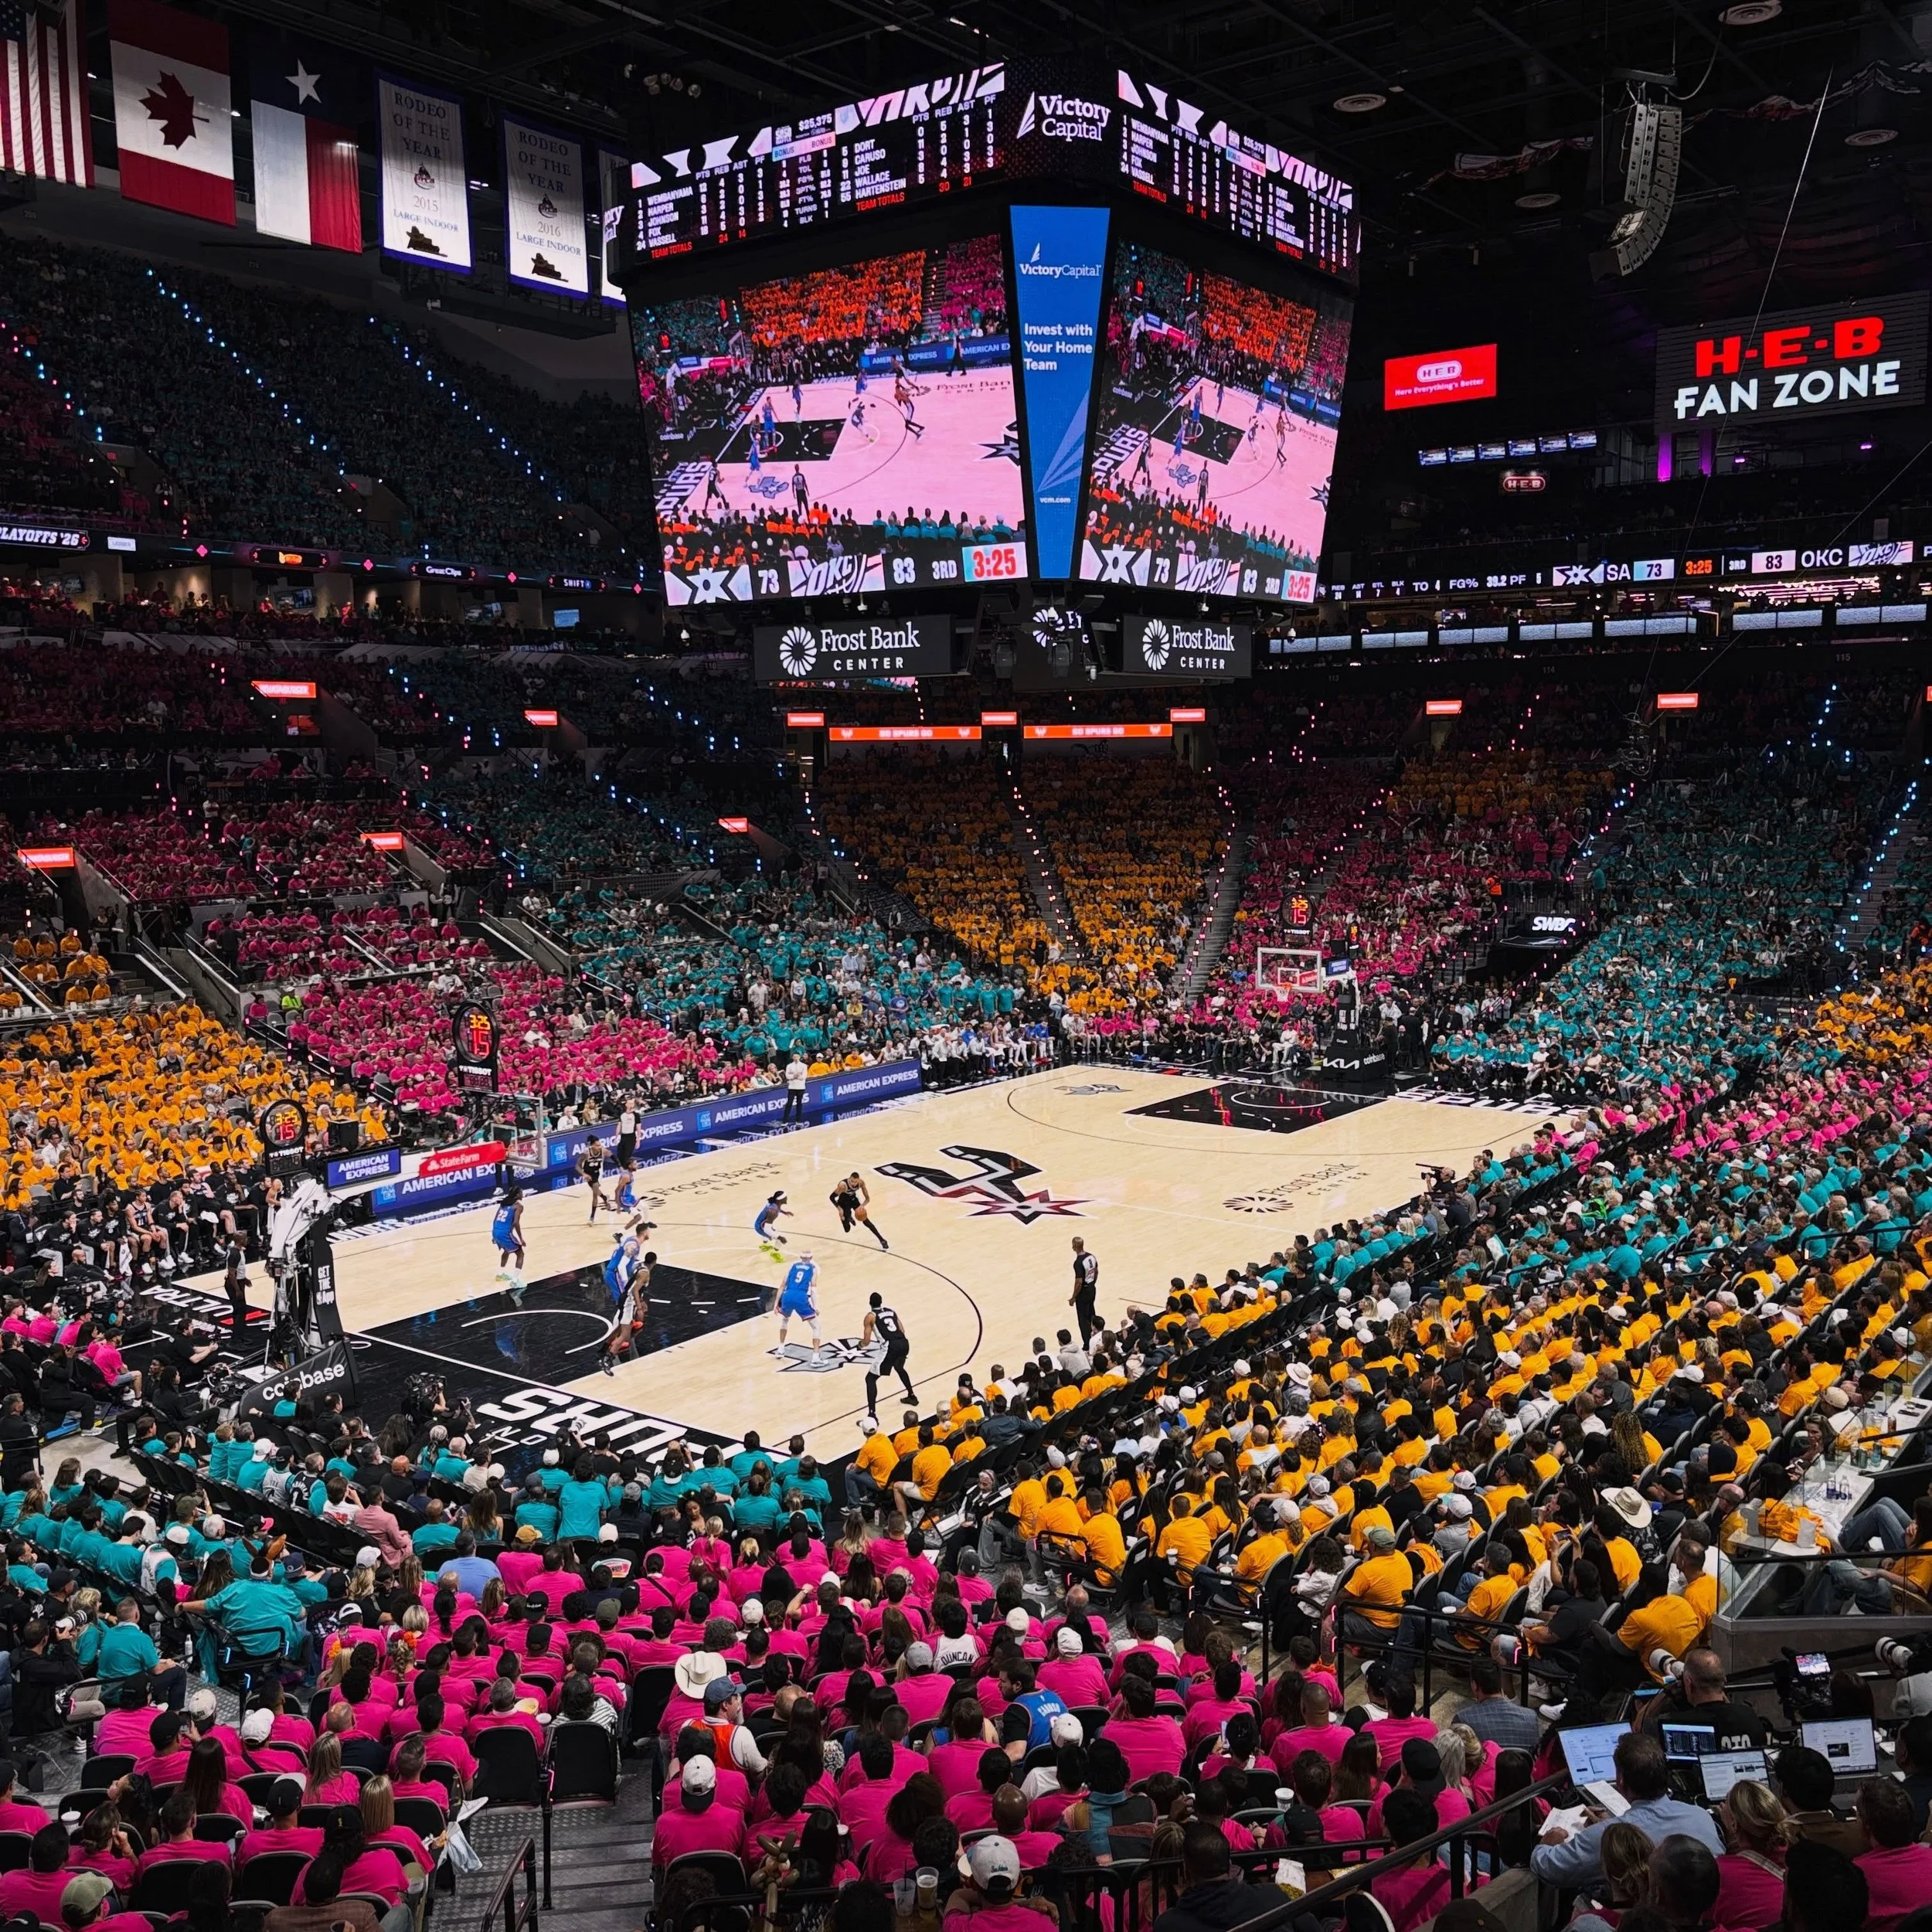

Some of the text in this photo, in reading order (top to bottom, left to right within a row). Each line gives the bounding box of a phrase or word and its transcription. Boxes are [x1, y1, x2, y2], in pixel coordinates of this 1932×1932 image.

[394, 92, 447, 120] RODEO
[912, 94, 996, 124] PTS REB AST PF
[1039, 94, 1111, 128] Victory
[393, 114, 451, 141] OF THE
[1042, 117, 1103, 141] Capital
[402, 137, 442, 161] YEAR
[519, 131, 568, 157] RODEO
[774, 137, 832, 158] BONUS BONUS
[854, 139, 876, 154] DORT
[1131, 131, 1153, 150] HARPER
[854, 148, 886, 165] CARUSO
[1131, 143, 1157, 164] JOHNSON
[1131, 155, 1143, 168] FOX
[519, 151, 571, 176] OF THE
[696, 155, 765, 181] PTS REB AST PF
[854, 164, 870, 177] JOE
[528, 172, 564, 193] YEAR
[840, 170, 890, 192] 22 WALLACE
[1120, 162, 1155, 185] 24 VASSELL
[647, 185, 694, 206] WEMBANYAMA
[840, 178, 906, 202] 55 HARTENSTEIN
[855, 176, 972, 212] TEAM TOTALS 30 21
[1133, 180, 1194, 214] TEAM TOTALS 24
[413, 196, 439, 213] 2015
[648, 202, 674, 216] HARPER
[798, 195, 814, 205] FT%
[794, 203, 818, 216] TURNS
[393, 209, 459, 233] LARGE INDOOR
[648, 211, 679, 227] JOHNSON
[799, 215, 813, 224] BLK
[537, 221, 561, 237] 2016
[648, 226, 662, 238] FOX
[515, 232, 582, 256] LARGE INDOOR
[636, 233, 677, 251] 24 VASSELL
[651, 229, 747, 259] TEAM TOTALS 24 14
[1024, 323, 1094, 336] Invest with
[1024, 340, 1094, 354] Your Home
[1024, 358, 1058, 371] Team
[1413, 382, 1459, 394] Everything's
[1460, 379, 1485, 387] Better
[1674, 359, 1901, 420] FAN ZONE
[60, 532, 80, 546] '26
[757, 548, 1017, 594] 73 83 3RD 3:25
[1155, 558, 1310, 599] 73 83 3RD 3:25
[1412, 581, 1429, 592] TO
[1434, 580, 1440, 591] 4
[1449, 578, 1479, 590] FG%
[1510, 574, 1526, 585] PF
[1607, 563, 1631, 581] SA
[1646, 563, 1662, 578] 73
[1685, 560, 1713, 575] 3:25
[1729, 560, 1747, 571] 3RD
[1766, 555, 1783, 570] 83
[1801, 548, 1843, 568] OKC
[820, 621, 920, 651] Frost Bank
[1171, 625, 1235, 651] Frost Bank
[833, 657, 905, 672] CENTER
[1180, 657, 1226, 670] CENTER
[1835, 653, 1851, 662] 115
[1543, 666, 1555, 675] 114
[892, 729, 934, 738] SPURS GO
[1085, 727, 1111, 736] SPURS
[1294, 909, 1307, 924] 15
[1532, 916, 1577, 932] SWBC
[469, 1015, 491, 1030] 3:25
[473, 1029, 490, 1058] 15
[1322, 1057, 1360, 1070] KIA
[1363, 1053, 1386, 1065] coinbase
[469, 1066, 492, 1076] TISSOT
[1182, 1071, 1263, 1084] ULTRA
[837, 1069, 918, 1096] AMERICAN EXPRESS
[715, 1102, 766, 1123] AMERICAN
[1386, 1090, 1596, 1118] SPURS
[275, 1110, 298, 1125] 3:25
[279, 1124, 295, 1141] 15
[278, 1146, 304, 1157] TISSOT
[338, 1154, 389, 1173] AMERICAN
[345, 1164, 389, 1180] EXPRESS
[402, 1169, 473, 1195] AMERICAN
[647, 1162, 782, 1196] Frost Bank
[694, 1171, 781, 1196] CENTER
[1256, 1179, 1311, 1196] Frost
[1300, 1163, 1360, 1183] Bank
[1307, 1172, 1371, 1196] CENTER
[497, 1210, 509, 1223] 22
[318, 1265, 330, 1279] GET
[795, 1270, 804, 1284] 9
[318, 1277, 331, 1291] THE
[139, 1284, 233, 1317] ULTRA
[884, 1318, 897, 1332] 3
[261, 1361, 346, 1401] cobase
[940, 1651, 974, 1667] DUNCAN
